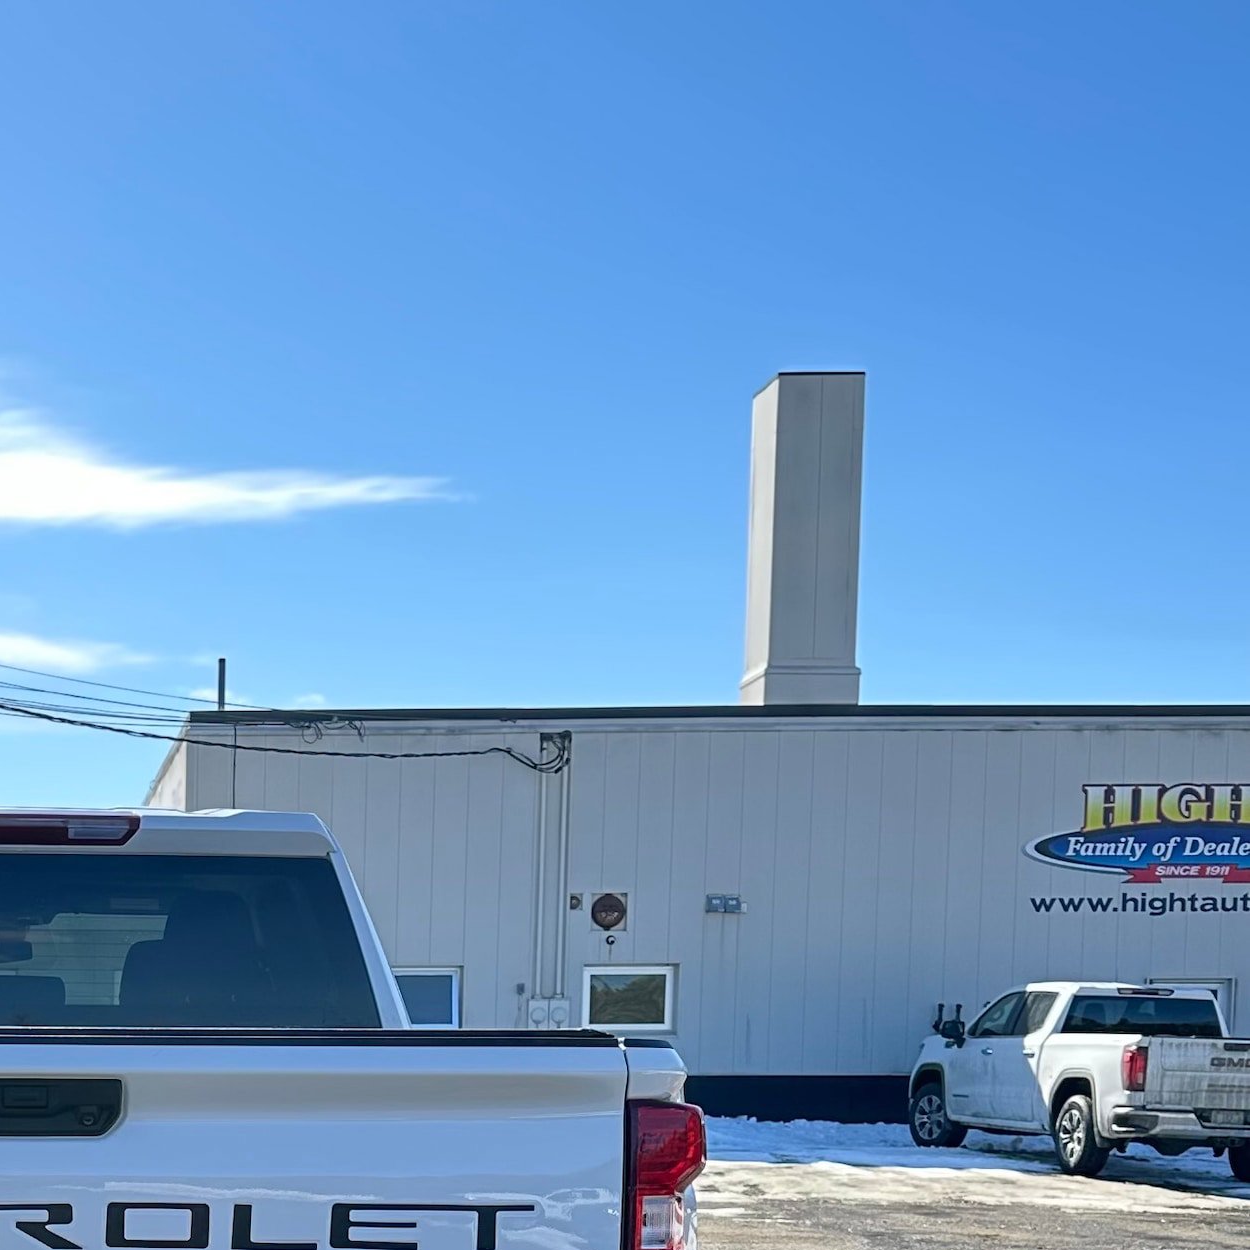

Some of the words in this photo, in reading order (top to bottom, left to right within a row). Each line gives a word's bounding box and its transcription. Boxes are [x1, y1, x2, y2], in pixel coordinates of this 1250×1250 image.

[1081, 783, 1250, 832] HIGH
[1066, 837, 1146, 862] Family
[1152, 837, 1180, 862] of
[1155, 865, 1201, 876] SINCE
[1205, 865, 1231, 876] 1911
